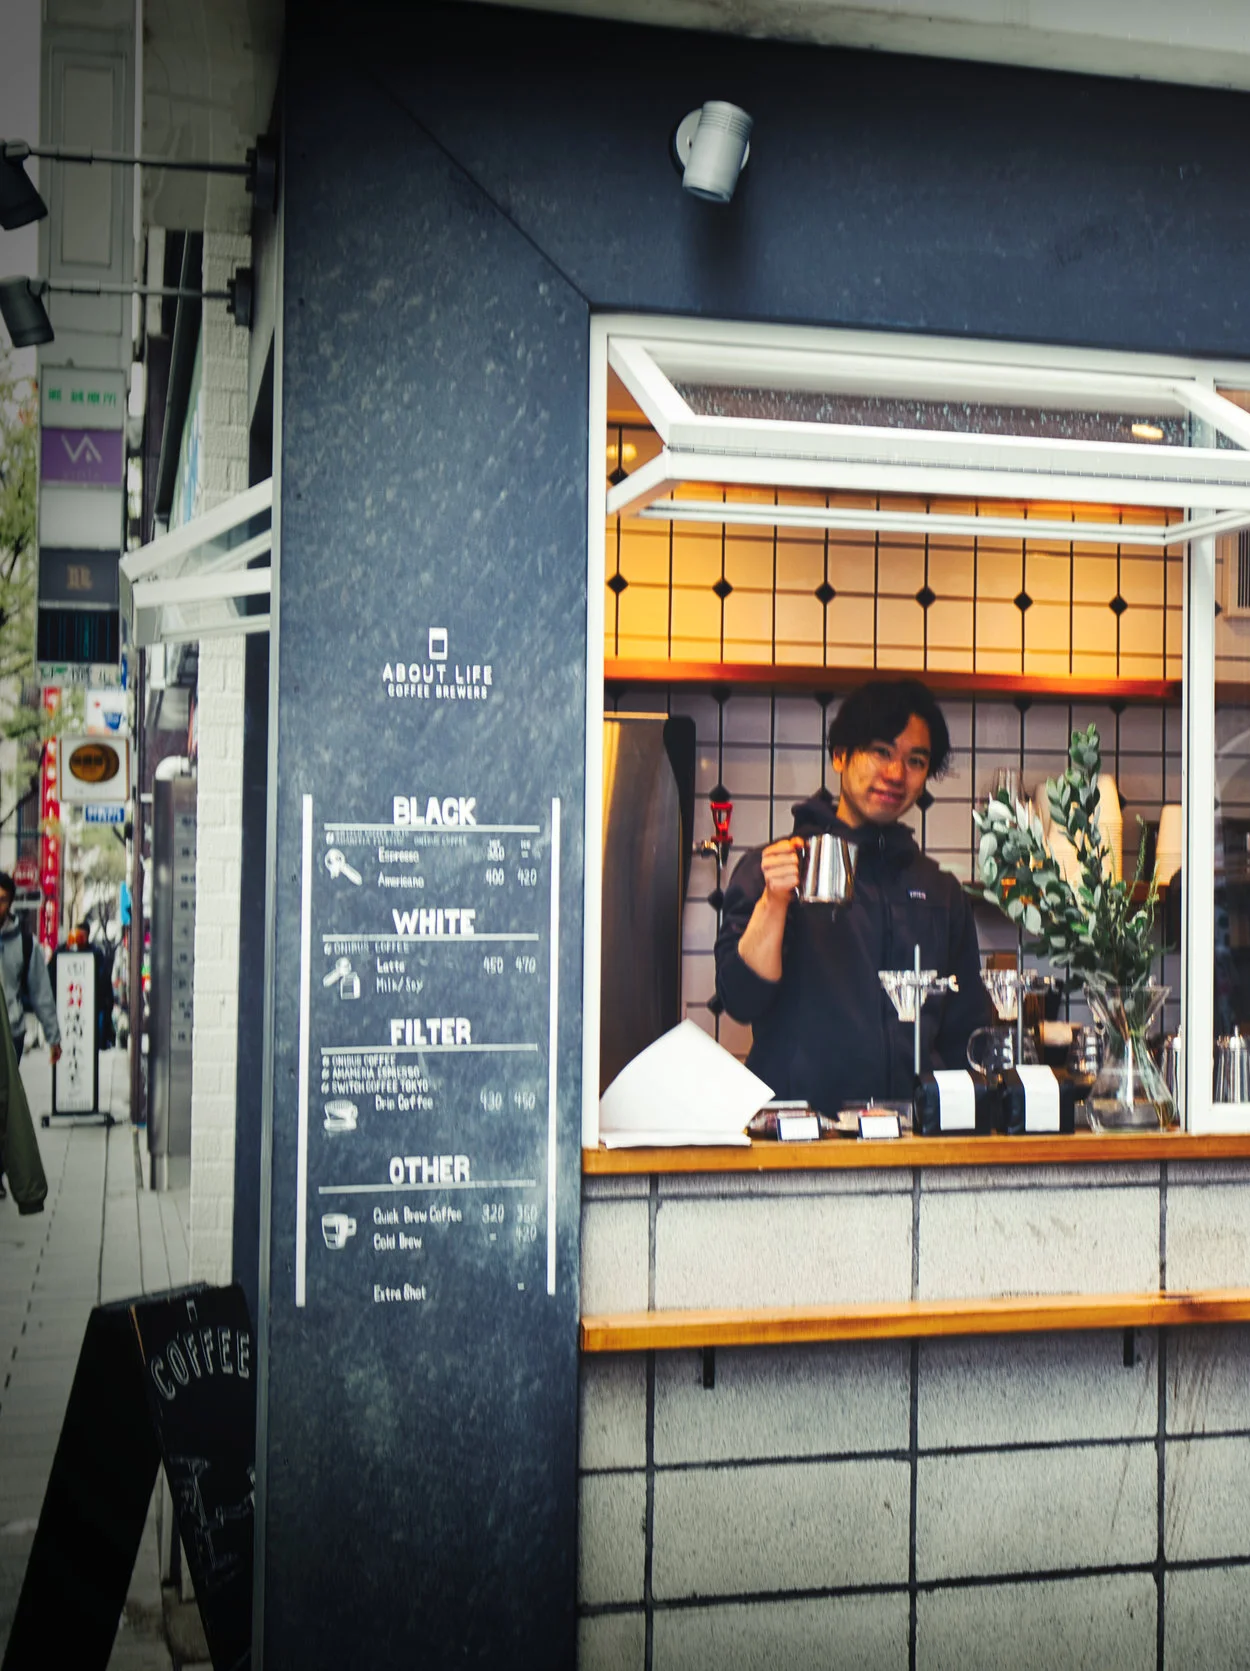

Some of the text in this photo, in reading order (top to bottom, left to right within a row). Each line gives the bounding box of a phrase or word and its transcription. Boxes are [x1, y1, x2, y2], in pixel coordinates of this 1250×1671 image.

[382, 662, 492, 685] ABOUT LIFE
[388, 683, 487, 699] COFFEE BREWERS
[393, 796, 476, 826] BLACK
[378, 846, 420, 864] Espresso
[378, 870, 424, 888] Americano
[392, 908, 476, 934] WHITE
[376, 956, 405, 973] Latte
[390, 1017, 471, 1045] FILTER
[400, 1078, 428, 1093] TOKYO
[397, 1093, 433, 1111] Coffee
[389, 1155, 470, 1184] OTHER
[373, 1206, 399, 1225] Quick
[403, 1206, 427, 1224] Brew
[429, 1204, 462, 1223] Coffee
[373, 1232, 396, 1251] Cold
[399, 1231, 422, 1250] Brew
[373, 1282, 427, 1303] Extra Shot
[151, 1327, 250, 1401] COFFEE
